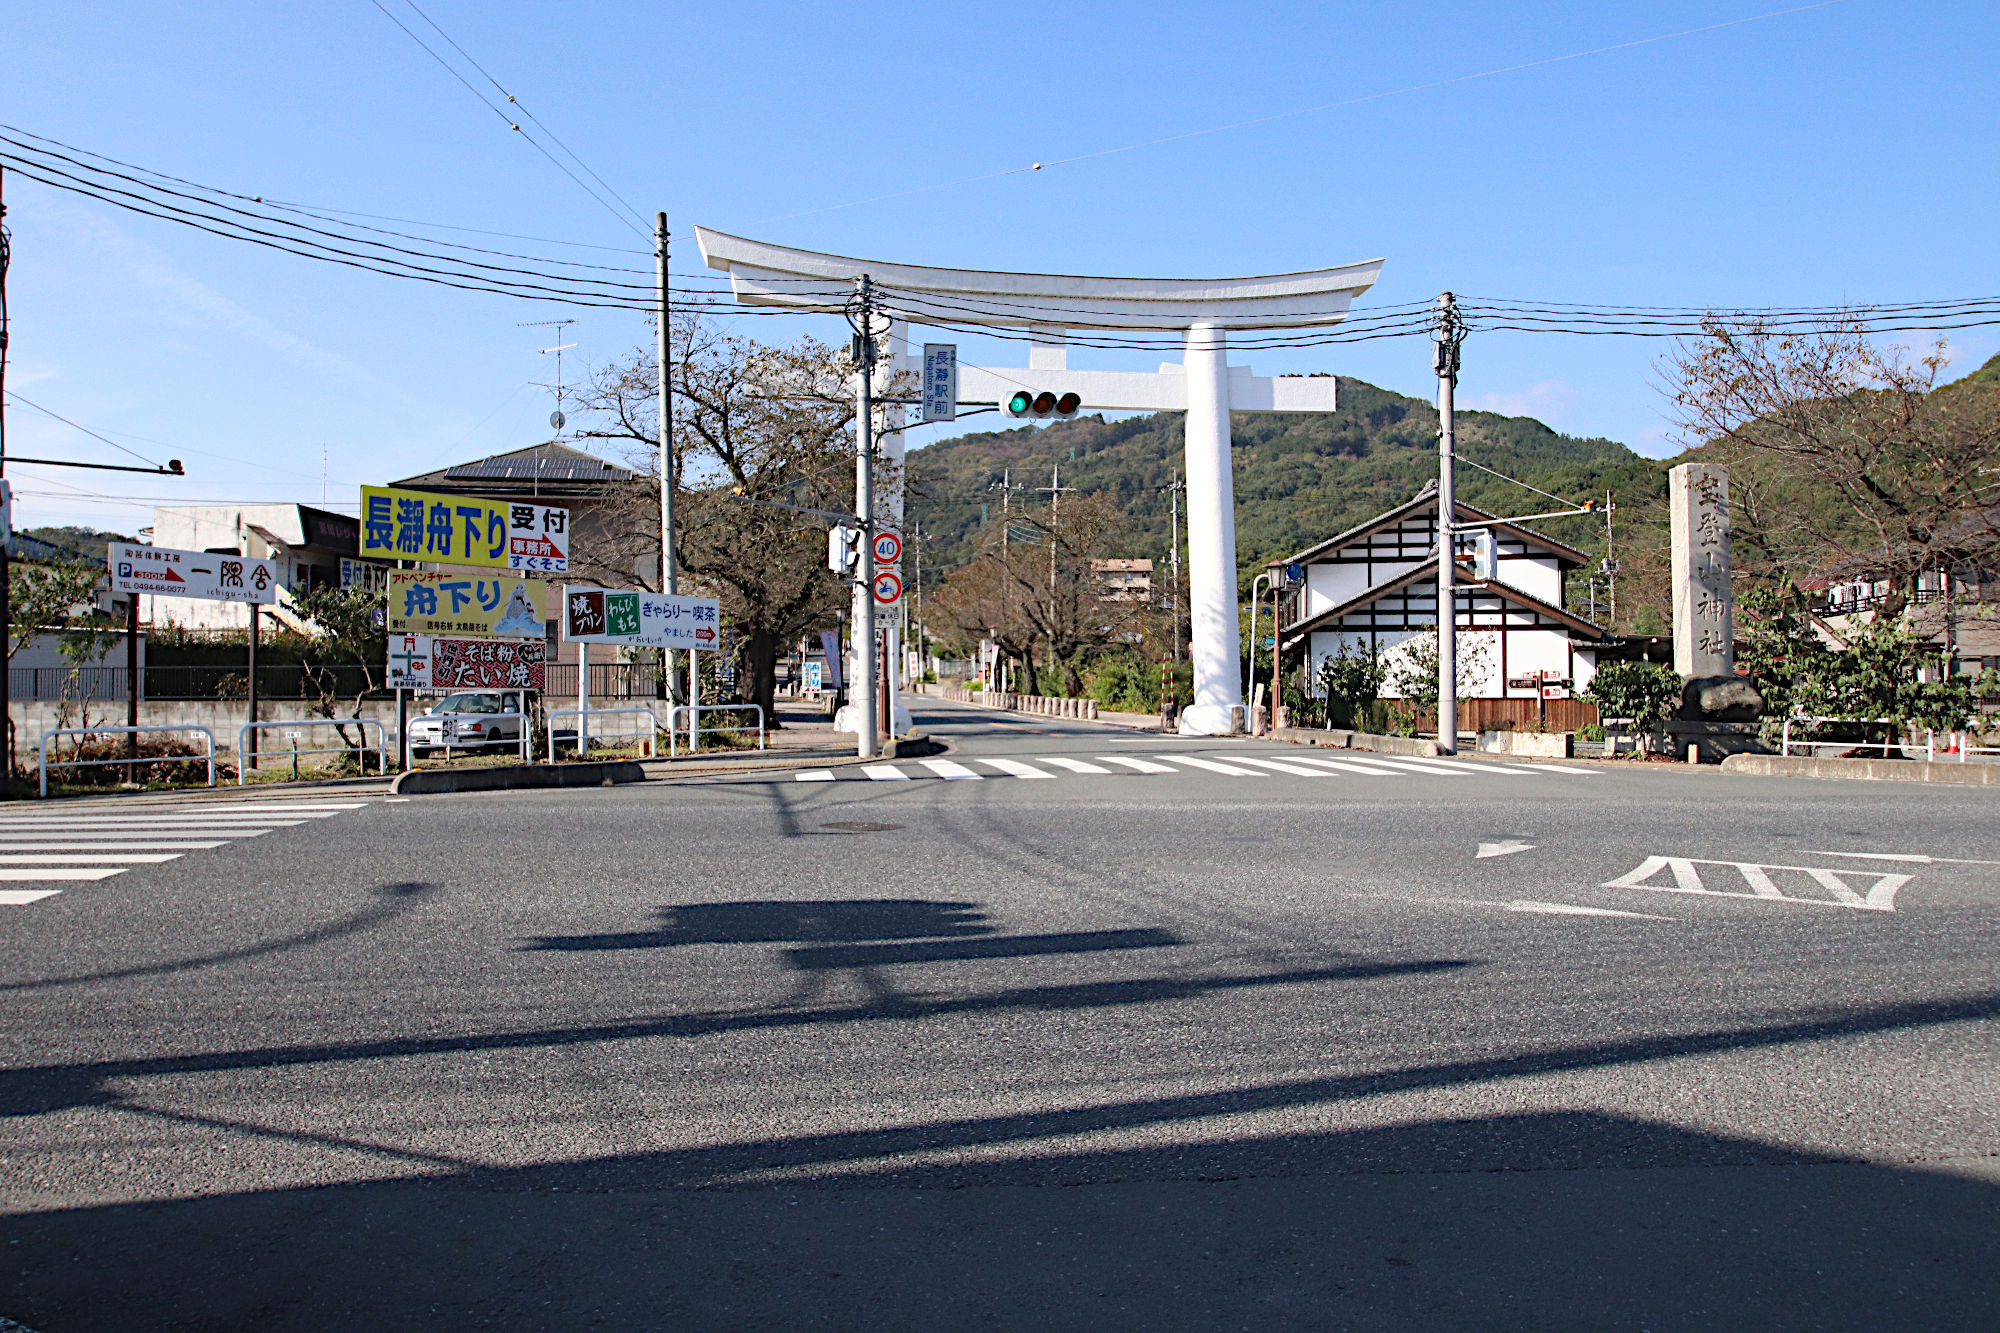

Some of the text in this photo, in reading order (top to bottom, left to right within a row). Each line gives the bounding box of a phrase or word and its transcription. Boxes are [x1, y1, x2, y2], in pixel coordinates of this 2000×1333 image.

[926, 355, 935, 391] Nagatoro
[935, 351, 949, 414] 長瀞駅前
[365, 495, 506, 559] 長瀞舟下り
[511, 505, 567, 534] 受付
[512, 539, 552, 556] 事務所
[878, 541, 895, 555] 40
[120, 564, 131, 577] P
[510, 555, 567, 572] すぐそこ
[119, 581, 132, 589] TEL
[392, 572, 453, 584] アドベンチャー
[404, 580, 501, 617] 舟下り
[571, 595, 593, 617] 焼
[608, 596, 634, 617] わらび
[642, 602, 716, 622] ぎゃらりー喫茶
[392, 619, 406, 629] 受付
[576, 613, 602, 633] プリン
[617, 613, 637, 632] もち
[664, 628, 693, 638] やました
[465, 644, 515, 663] そば粉
[454, 662, 532, 688] たい焼
